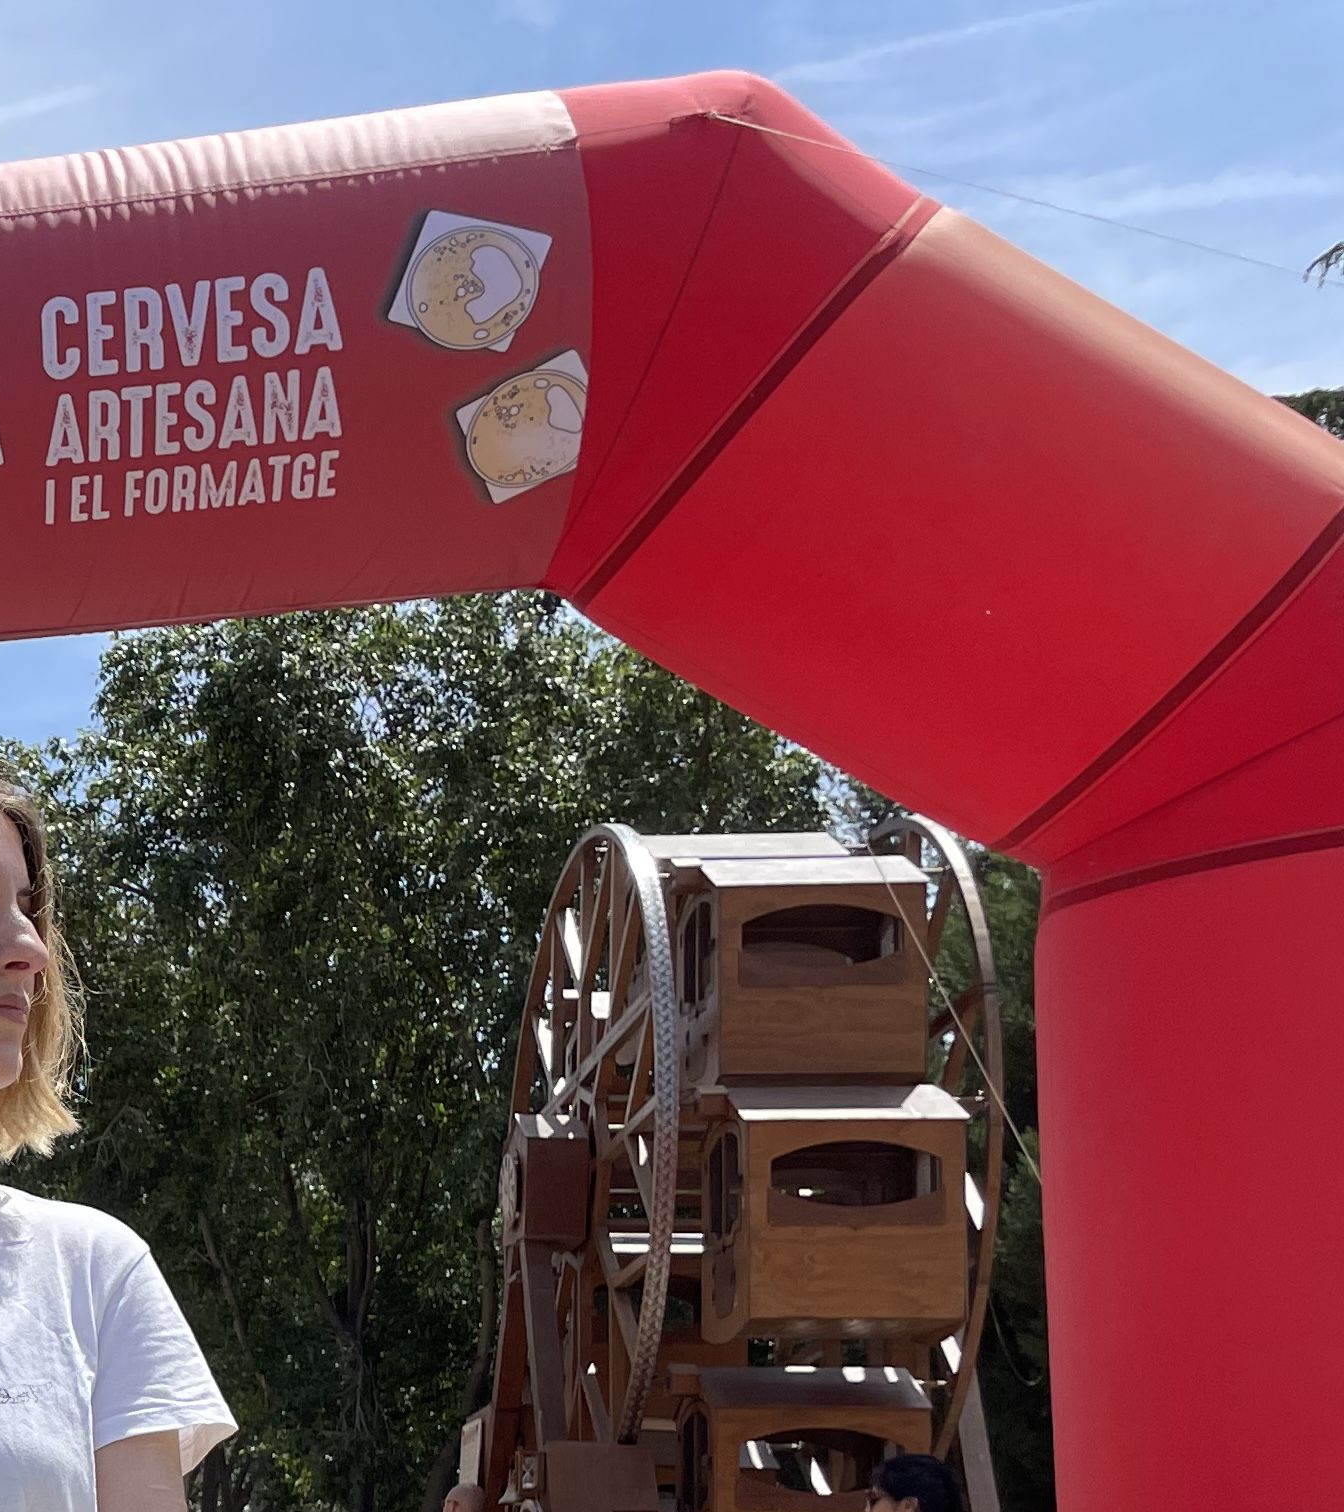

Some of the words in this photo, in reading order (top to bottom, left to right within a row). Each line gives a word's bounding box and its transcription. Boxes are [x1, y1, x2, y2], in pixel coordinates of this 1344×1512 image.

[41, 267, 343, 380] CERVESA
[45, 366, 342, 467] ARTESANA
[45, 479, 55, 525] I
[70, 474, 110, 522] EL
[124, 450, 340, 517] FORMATGE
